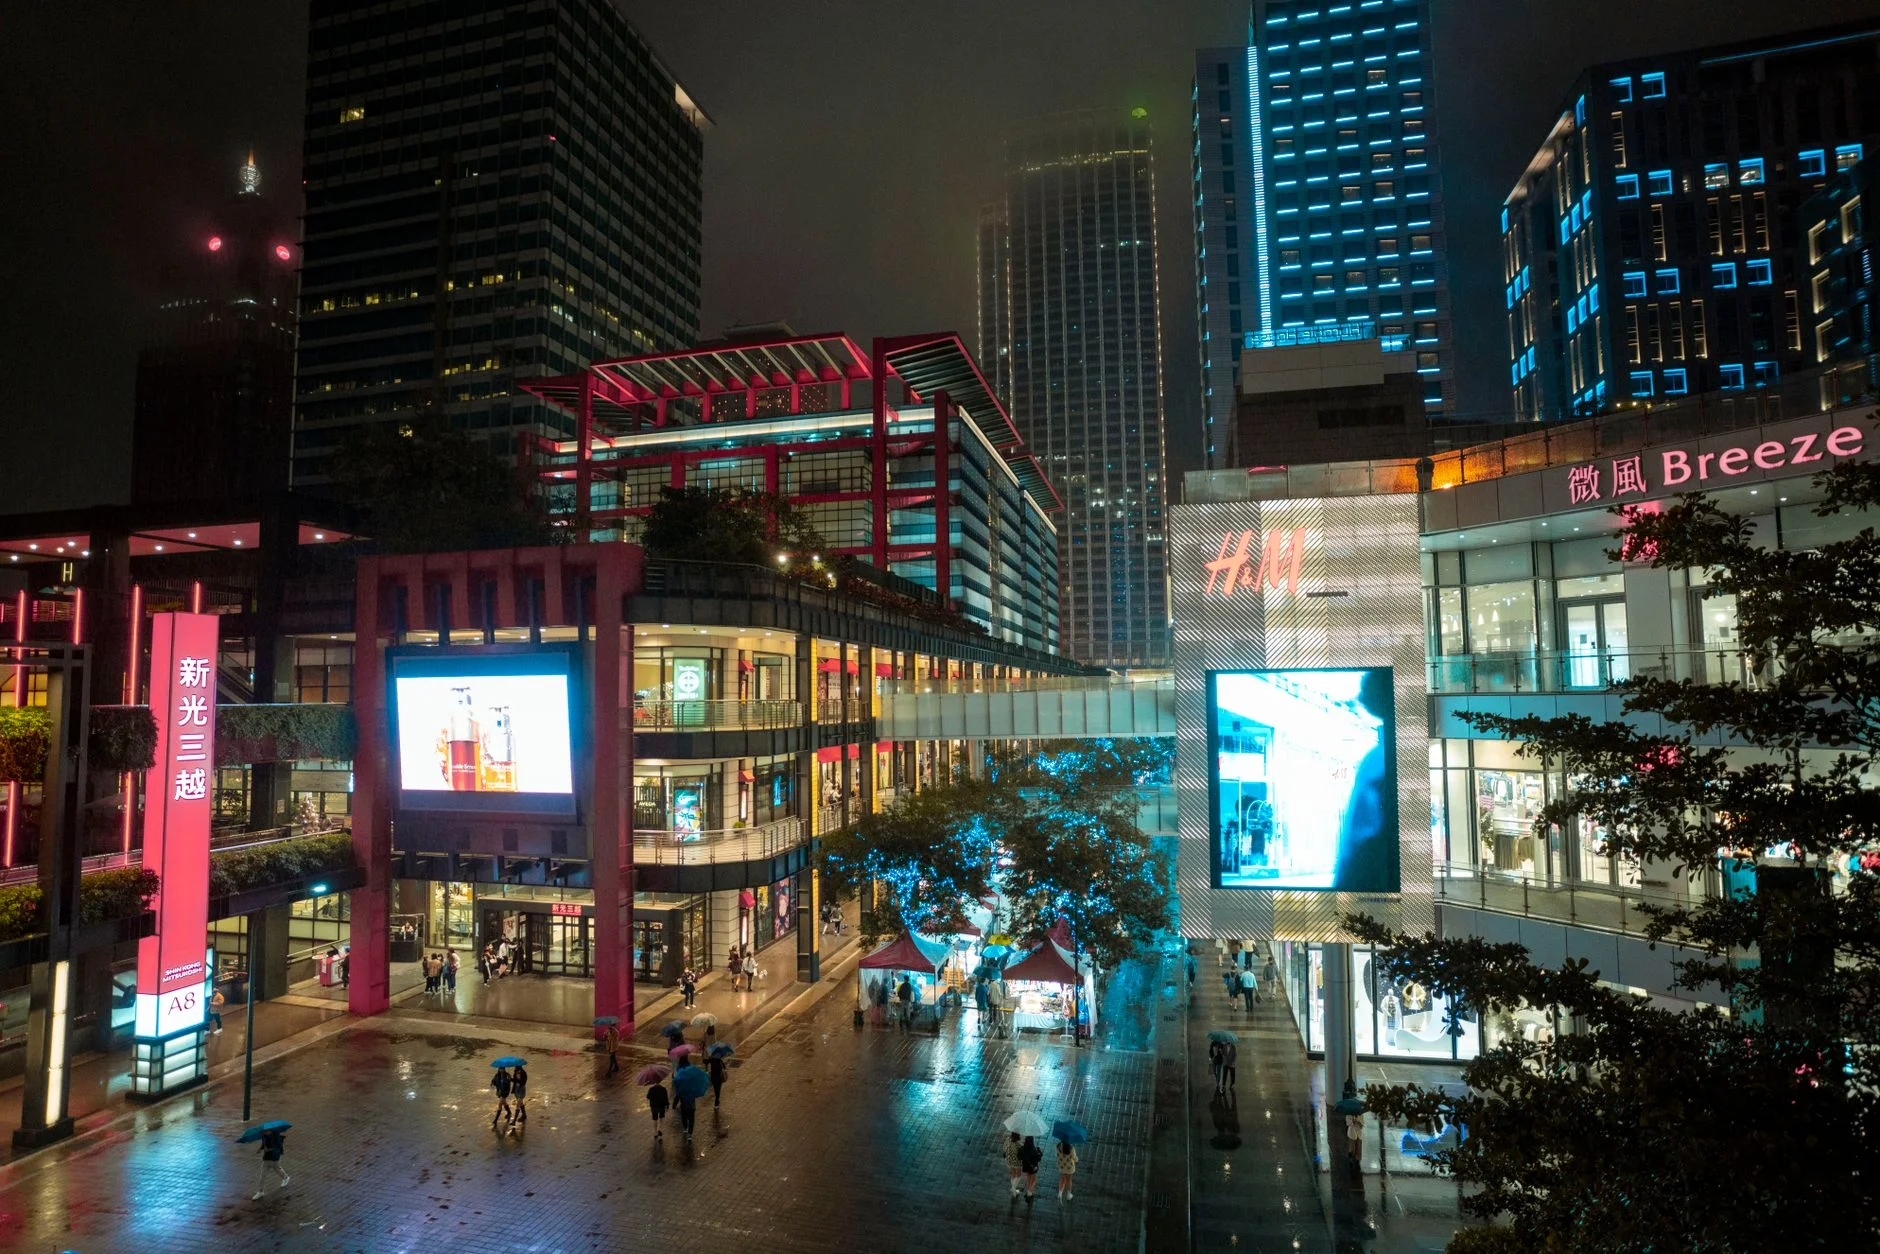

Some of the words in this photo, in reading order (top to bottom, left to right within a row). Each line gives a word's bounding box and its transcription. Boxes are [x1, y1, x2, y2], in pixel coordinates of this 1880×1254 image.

[1567, 455, 1647, 504] 微風
[1661, 426, 1864, 486] Breeze
[1203, 527, 1306, 596] H&M
[174, 656, 211, 801] 新光三越
[551, 903, 582, 913] 新光三越
[162, 968, 203, 983] MITSUKOSHI
[165, 967, 182, 976] SHIN
[183, 961, 201, 970] KONG
[168, 992, 196, 1016] A8
